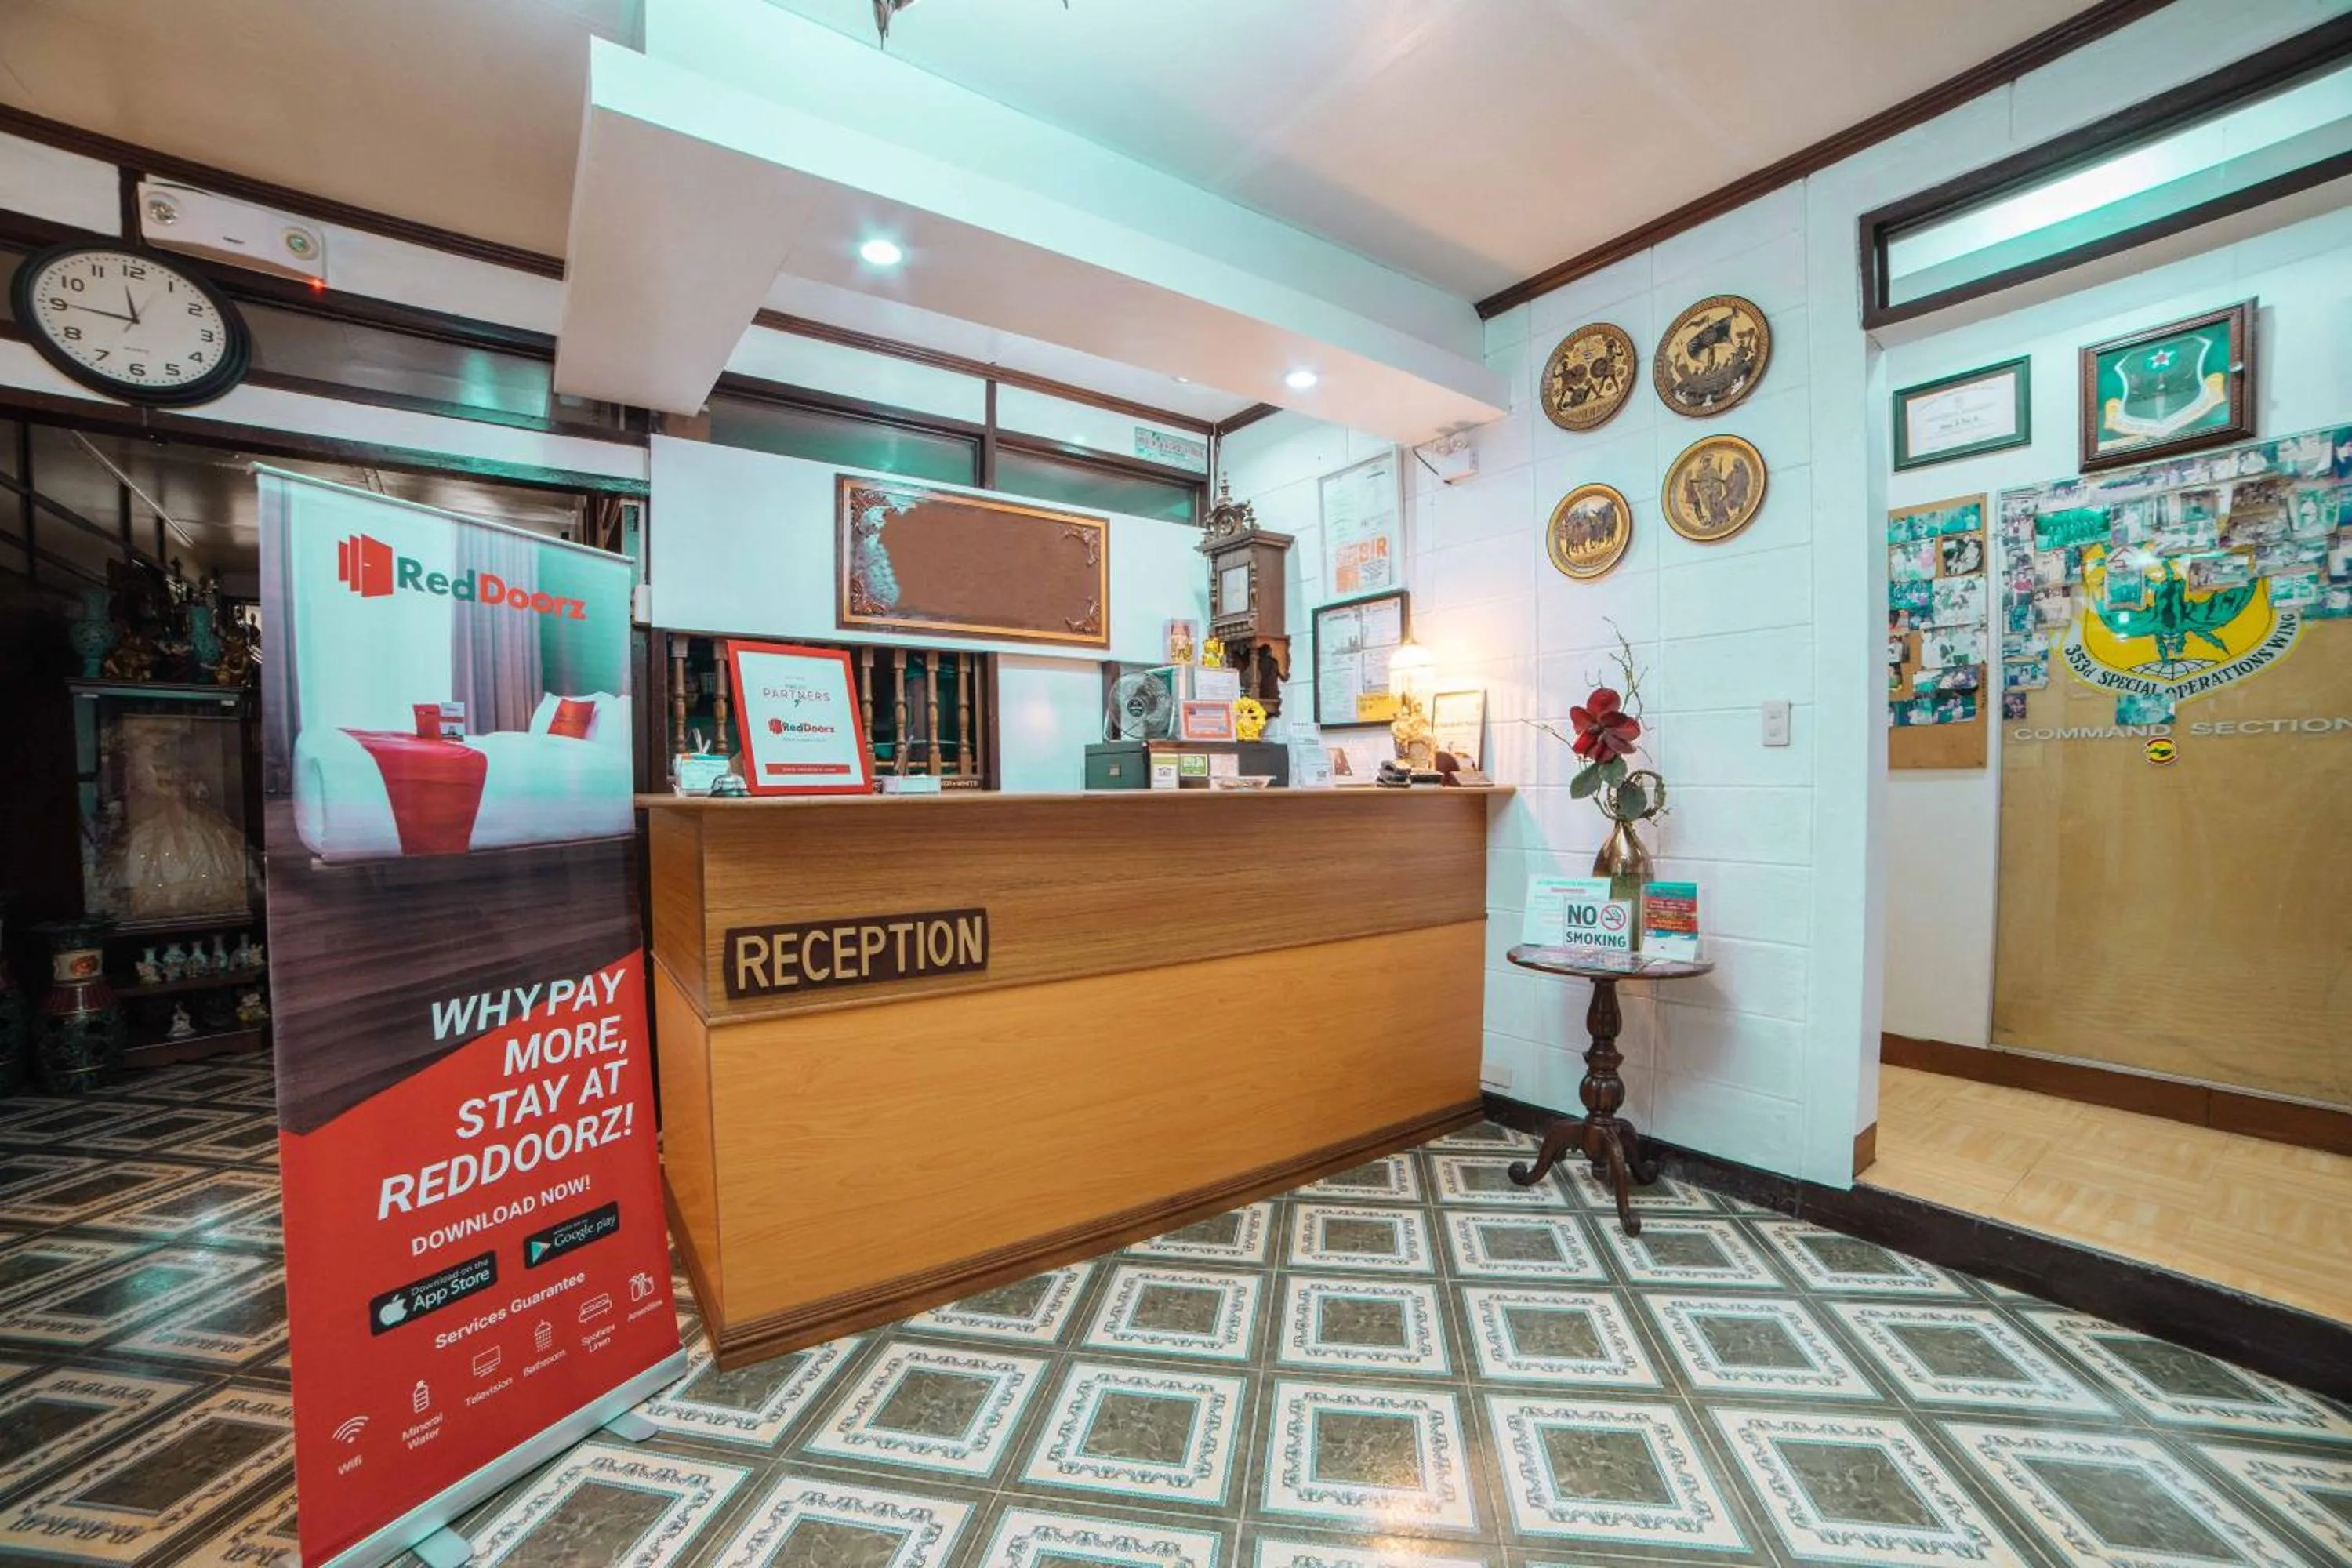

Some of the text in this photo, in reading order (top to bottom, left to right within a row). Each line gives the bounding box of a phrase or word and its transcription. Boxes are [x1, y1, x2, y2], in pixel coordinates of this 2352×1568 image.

[91, 264, 104, 278] 11
[122, 263, 146, 280] 12
[61, 275, 85, 292] 10
[168, 280, 174, 293] 1
[50, 297, 67, 311] 9
[187, 303, 204, 318] 2
[64, 326, 82, 340] 8
[200, 328, 214, 343] 3
[95, 349, 110, 362] 7
[188, 350, 204, 363] 4
[129, 363, 146, 377] 6
[165, 363, 180, 376] 5
[397, 556, 586, 620] RedDoorz
[2097, 670, 2158, 695] SPECIAL
[2267, 613, 2296, 649] WING
[762, 688, 831, 702] PARTNERS
[782, 721, 836, 733] RedDoorz
[2013, 724, 2172, 740] COMMAND
[1568, 904, 1598, 925] NO
[1566, 931, 1627, 948] SMOKING
[736, 916, 983, 990] RECEPTION
[432, 968, 626, 1040] WHY PAY
[503, 1015, 628, 1076] MORE,
[456, 1059, 628, 1139] STAY AT
[377, 1102, 634, 1221] REDDOORZ!
[412, 1174, 590, 1256] DOWNLOAD NOW!
[554, 1225, 594, 1248] Google
[596, 1214, 616, 1234] play
[413, 1269, 490, 1312] App Store
[435, 1272, 586, 1349] Services Guarantee
[464, 1377, 513, 1406] Television
[402, 1411, 444, 1441] Mineral
[407, 1427, 441, 1450] Water
[338, 1454, 363, 1475] Wifi
